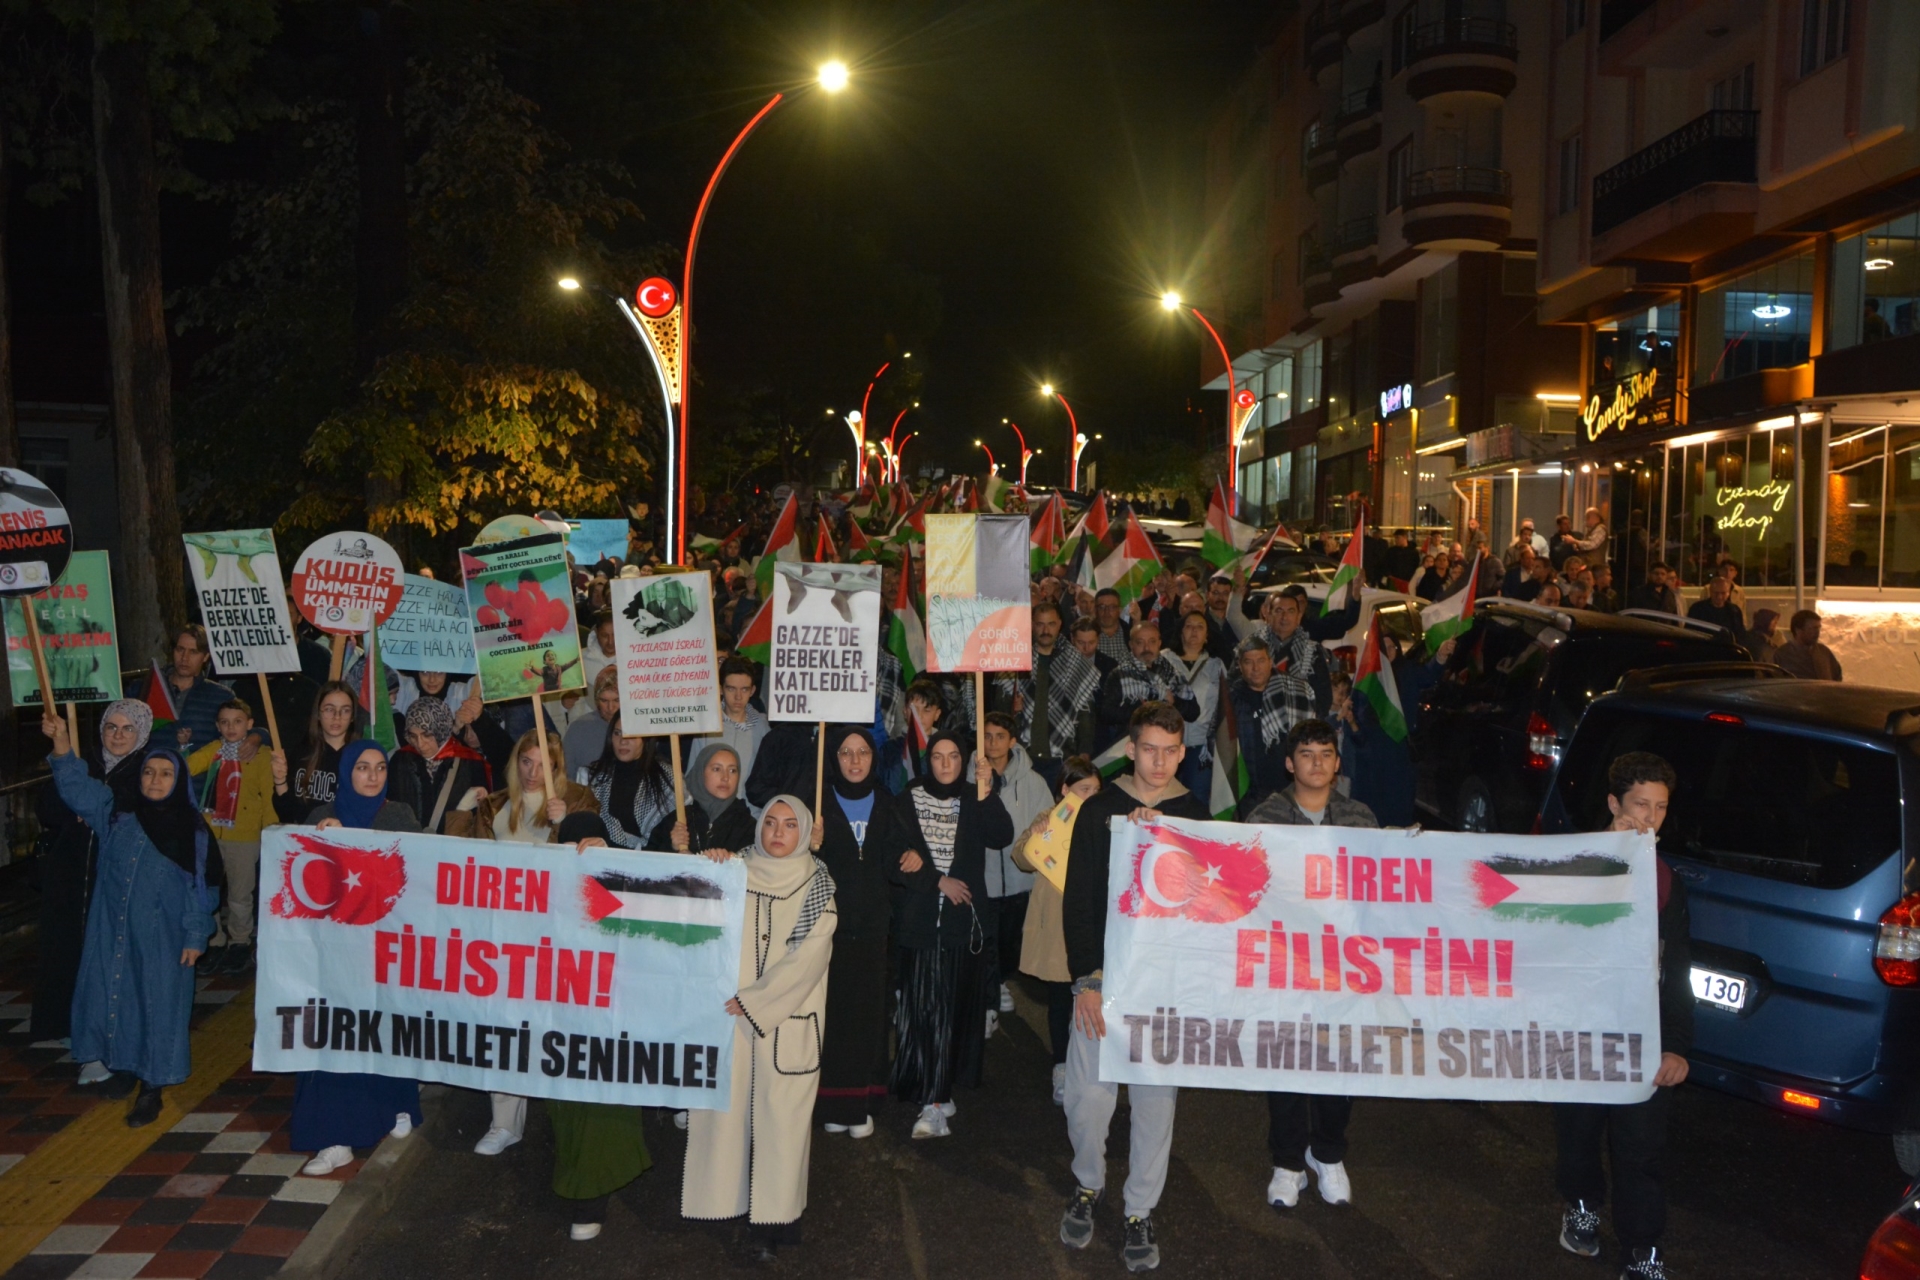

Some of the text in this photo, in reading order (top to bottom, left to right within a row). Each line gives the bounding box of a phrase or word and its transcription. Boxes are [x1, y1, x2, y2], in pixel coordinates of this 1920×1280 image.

[1584, 367, 1657, 441] Candy Shop
[1716, 479, 1791, 512] candy
[1717, 502, 1773, 541] shop
[505, 551, 529, 560] ARALIK
[509, 558, 543, 569] ÇOCUKLAR
[543, 553, 562, 564] GÜNÜ
[305, 557, 396, 586] KUDÜS
[202, 587, 270, 608] GAZZE'DE
[305, 575, 390, 600] ÜMMETİN
[206, 607, 277, 628] BEBEKLER
[474, 617, 523, 633] BERRAK BİR
[211, 625, 291, 648] KATLEDİLİ-
[675, 637, 706, 650] İSRAİL!
[776, 624, 860, 647] GAZZE'DE
[978, 628, 1020, 641] GÖRÜŞ
[489, 641, 554, 658] ÇOCUKLAR AŞKINA
[978, 641, 1028, 654] AYRILIĞI
[215, 649, 249, 668] YOR.
[627, 656, 668, 669] ENKAZINI
[775, 648, 863, 670] BEBEKLER
[978, 657, 1024, 669] OLMAZ.
[628, 668, 710, 685] SANA ÜLKE DİYENİN
[774, 669, 875, 693] KATLEDİLİ-
[628, 688, 661, 700] YÜZÜNE
[774, 693, 812, 714] YOR.
[634, 704, 708, 715] ÜSTAD NECİP FAZIL
[649, 715, 695, 725] KISAKÜREK
[436, 856, 550, 914] DİREN
[1304, 846, 1433, 904] DİREN
[374, 924, 616, 1009] FİLİSTİN!
[1235, 920, 1514, 999] FİLİSTİN!
[1704, 976, 1741, 1003] 130
[276, 998, 719, 1090] TÜRK MİLLETİ SENİNLE!
[1123, 1007, 1643, 1083] TÜRK MİLLETİ SENİNLE!
